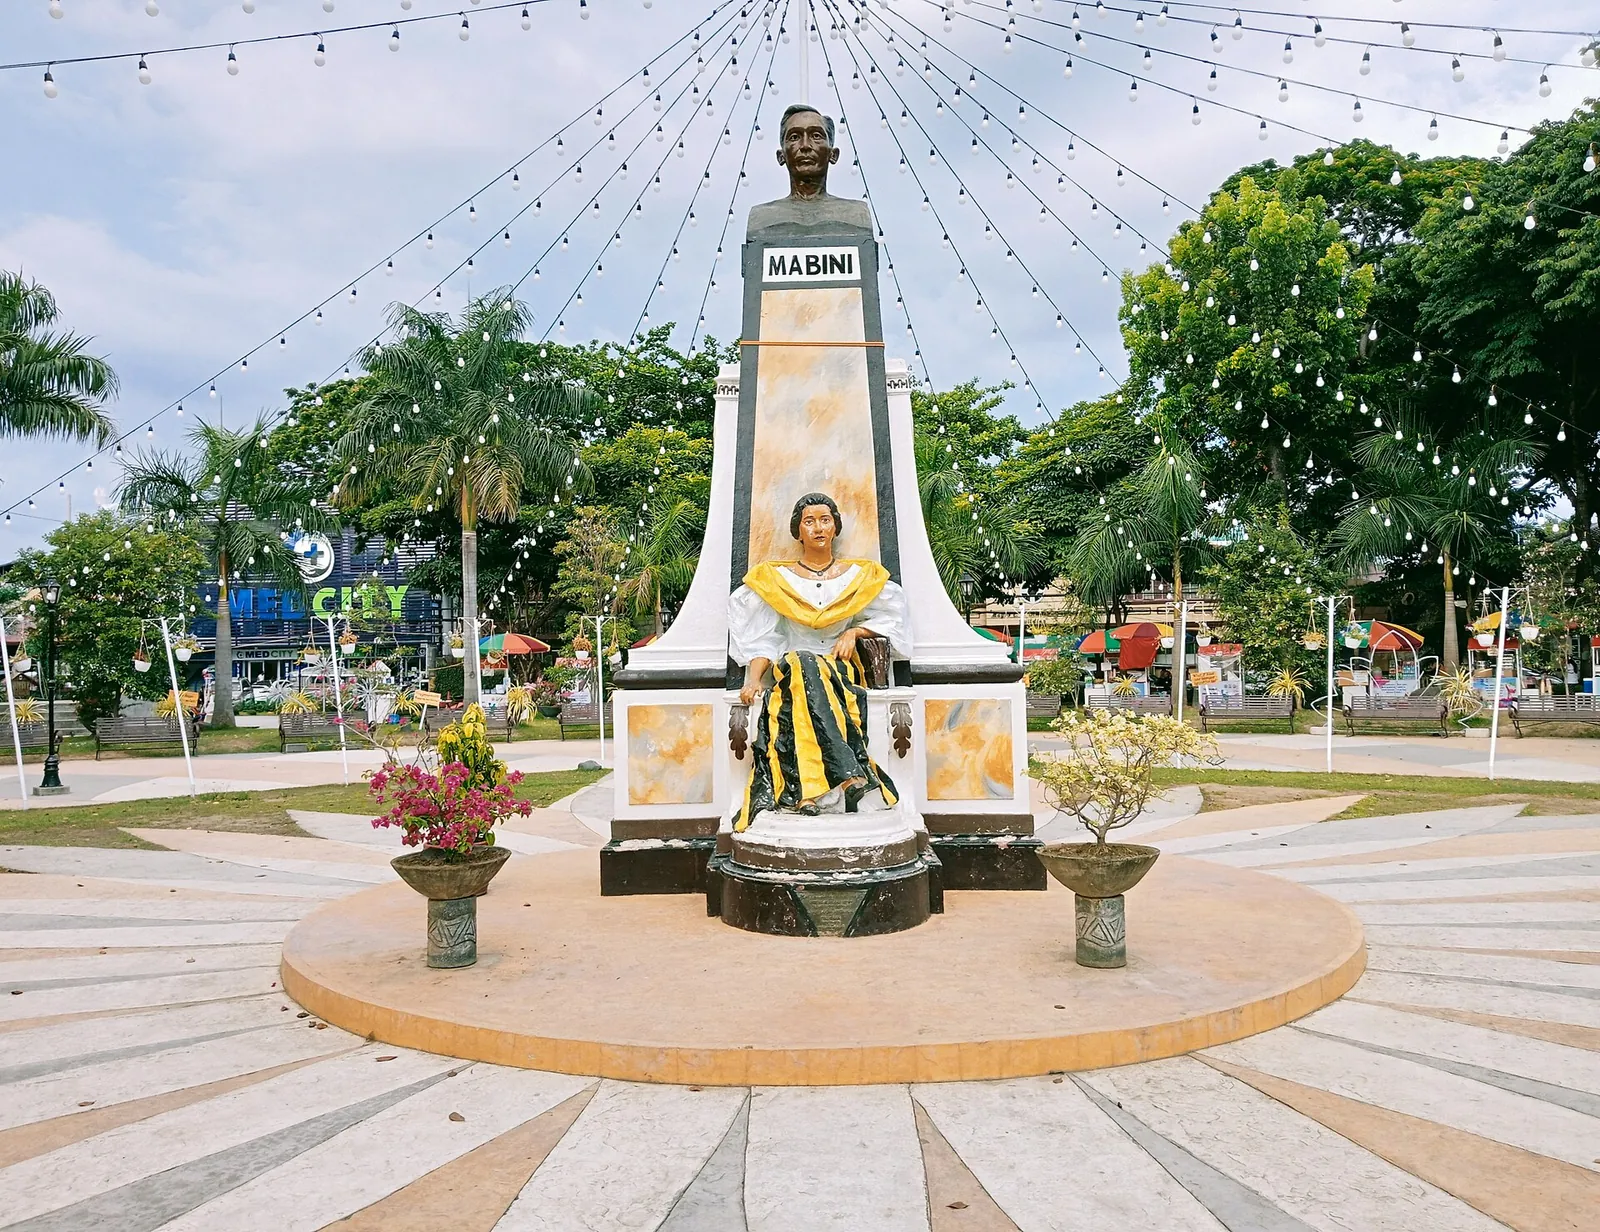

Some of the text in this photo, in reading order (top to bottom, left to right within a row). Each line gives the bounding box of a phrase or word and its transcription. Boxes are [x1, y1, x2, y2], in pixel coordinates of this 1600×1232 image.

[768, 253, 853, 276] MABINI
[229, 586, 409, 620] MED CITY
